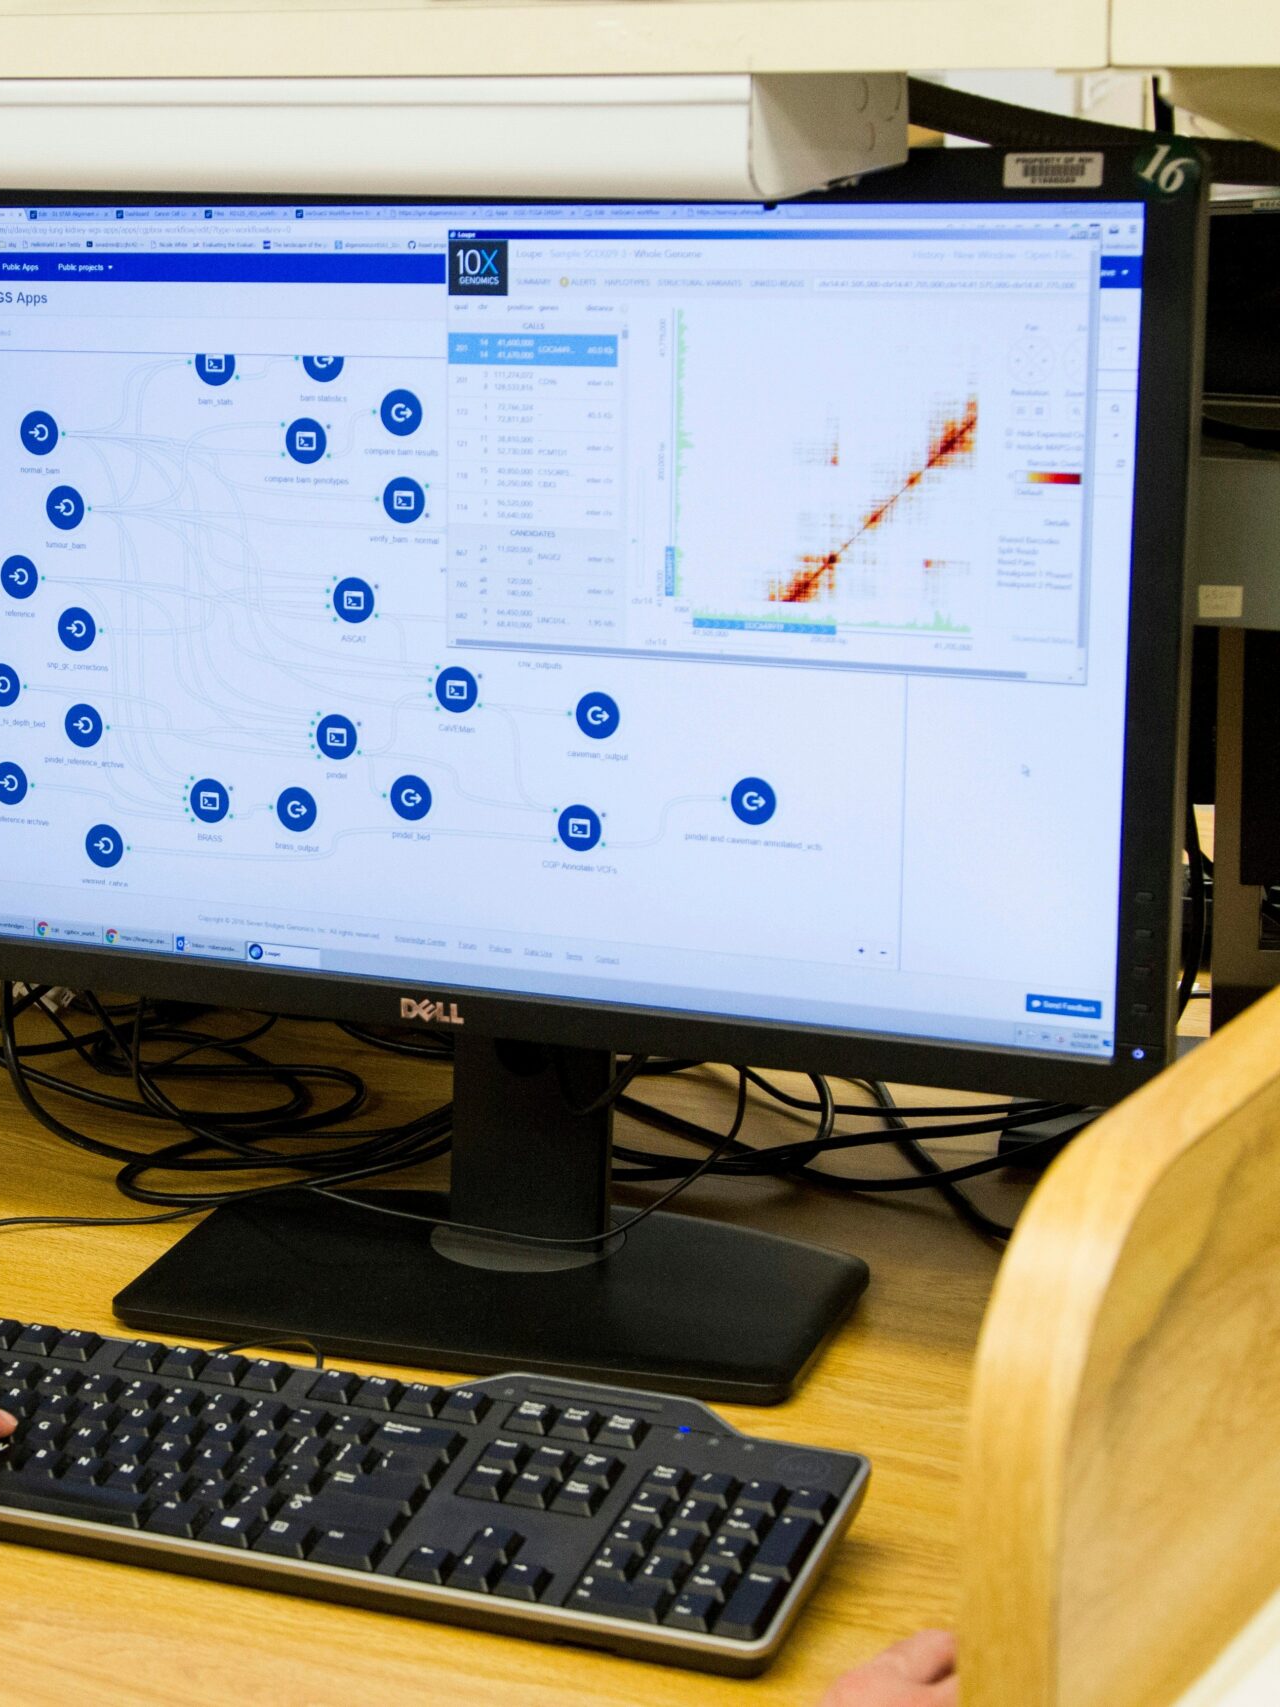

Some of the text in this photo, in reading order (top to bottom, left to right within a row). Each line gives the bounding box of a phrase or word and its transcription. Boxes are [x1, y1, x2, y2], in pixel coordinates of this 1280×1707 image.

[1139, 145, 1197, 193] 16
[633, 250, 662, 259] Whole
[664, 249, 703, 259] Genome
[2, 262, 20, 272] Public
[22, 262, 39, 272] Apps
[58, 262, 104, 272] Public projects
[456, 249, 499, 275] 10X
[459, 276, 500, 286] GENOMICS
[571, 278, 596, 287] ALERTS
[16, 292, 48, 306] Apps
[198, 397, 233, 407] bam_stats
[364, 447, 398, 457] compare
[20, 466, 60, 475] normal_bam
[264, 475, 294, 485] compare
[5, 609, 35, 618] reference
[197, 833, 223, 843] BRASS
[400, 997, 464, 1024] DELL
[1043, 1000, 1096, 1012] Send Feedback
[136, 1340, 147, 1348] F5
[9, 1388, 20, 1397] R
[51, 1394, 61, 1403] T
[92, 1401, 103, 1410] Y
[132, 1408, 144, 1418] U
[38, 1421, 50, 1430] G
[78, 1427, 92, 1437] H
[255, 1429, 268, 1438] P
[119, 1435, 131, 1443] J
[161, 1442, 174, 1451] K
[35, 1449, 47, 1459] B
[203, 1449, 212, 1458] L
[77, 1456, 91, 1466] N
[119, 1463, 135, 1474] M
